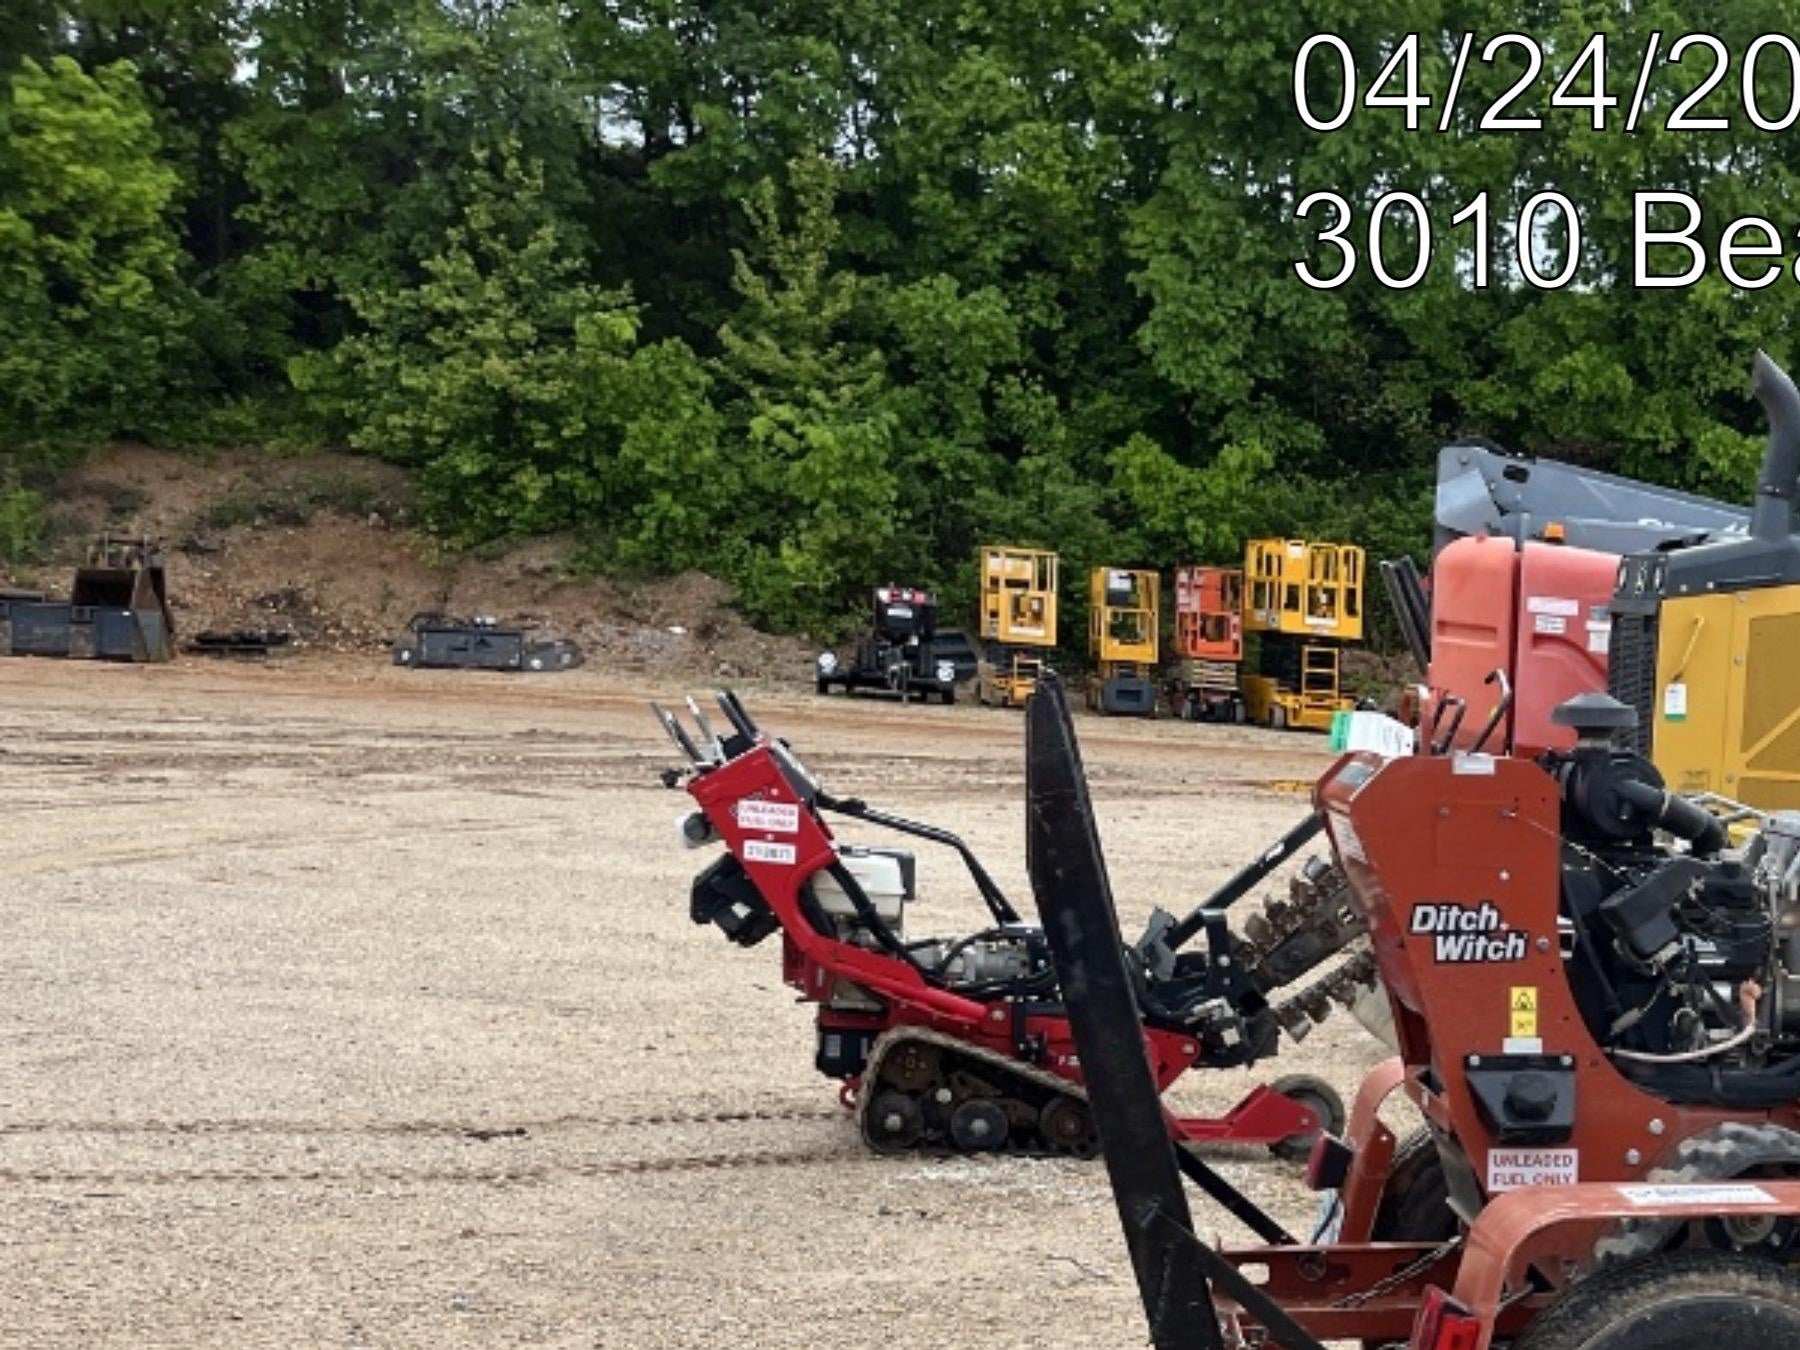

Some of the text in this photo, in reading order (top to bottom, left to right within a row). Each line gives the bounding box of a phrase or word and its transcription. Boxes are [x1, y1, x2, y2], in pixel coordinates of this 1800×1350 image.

[1411, 902, 1499, 933] Ditch
[1435, 932, 1527, 962] Witch
[1493, 1153, 1573, 1168] UNLEADED
